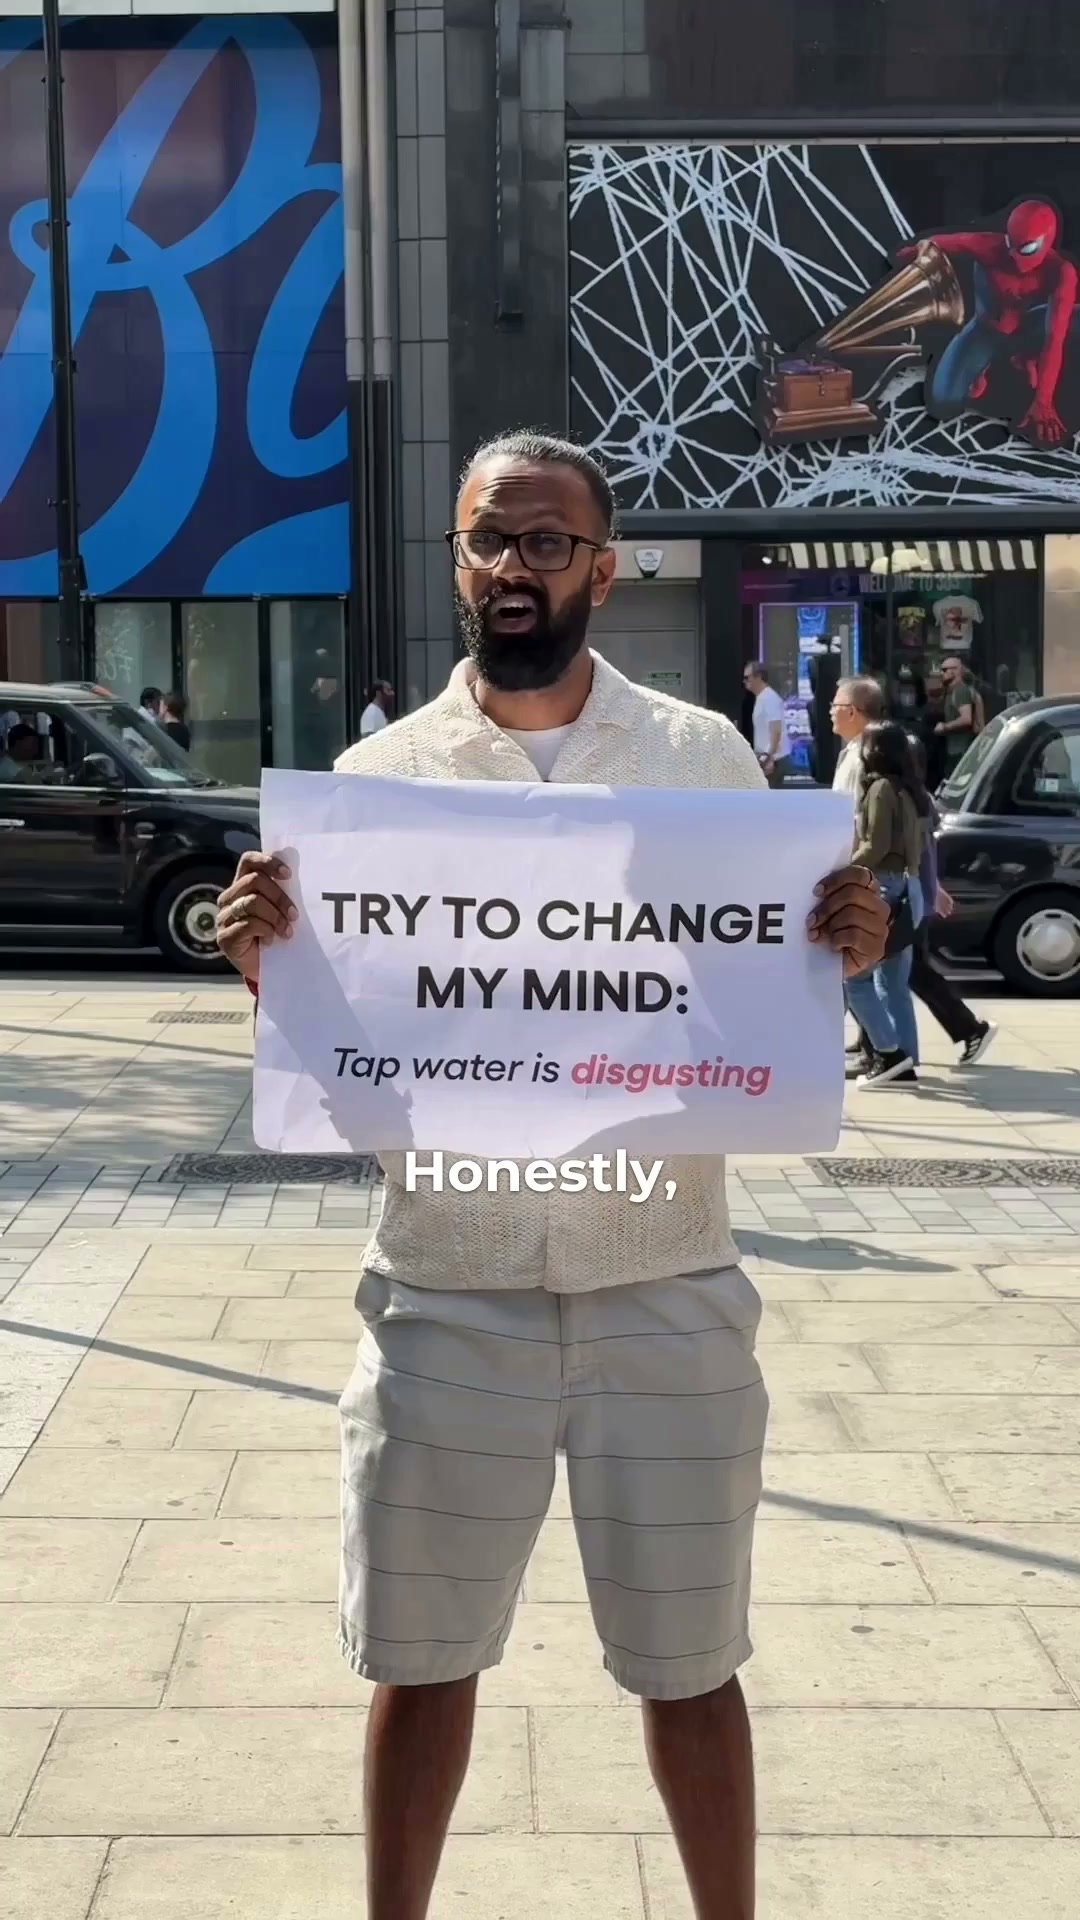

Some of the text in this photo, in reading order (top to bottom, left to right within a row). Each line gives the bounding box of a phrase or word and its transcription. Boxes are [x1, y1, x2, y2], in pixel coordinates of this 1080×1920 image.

[321, 892, 786, 945] TRY TO CHANGE
[416, 966, 688, 1015] MY MIND:
[333, 1047, 772, 1097] Tap water is disgusting
